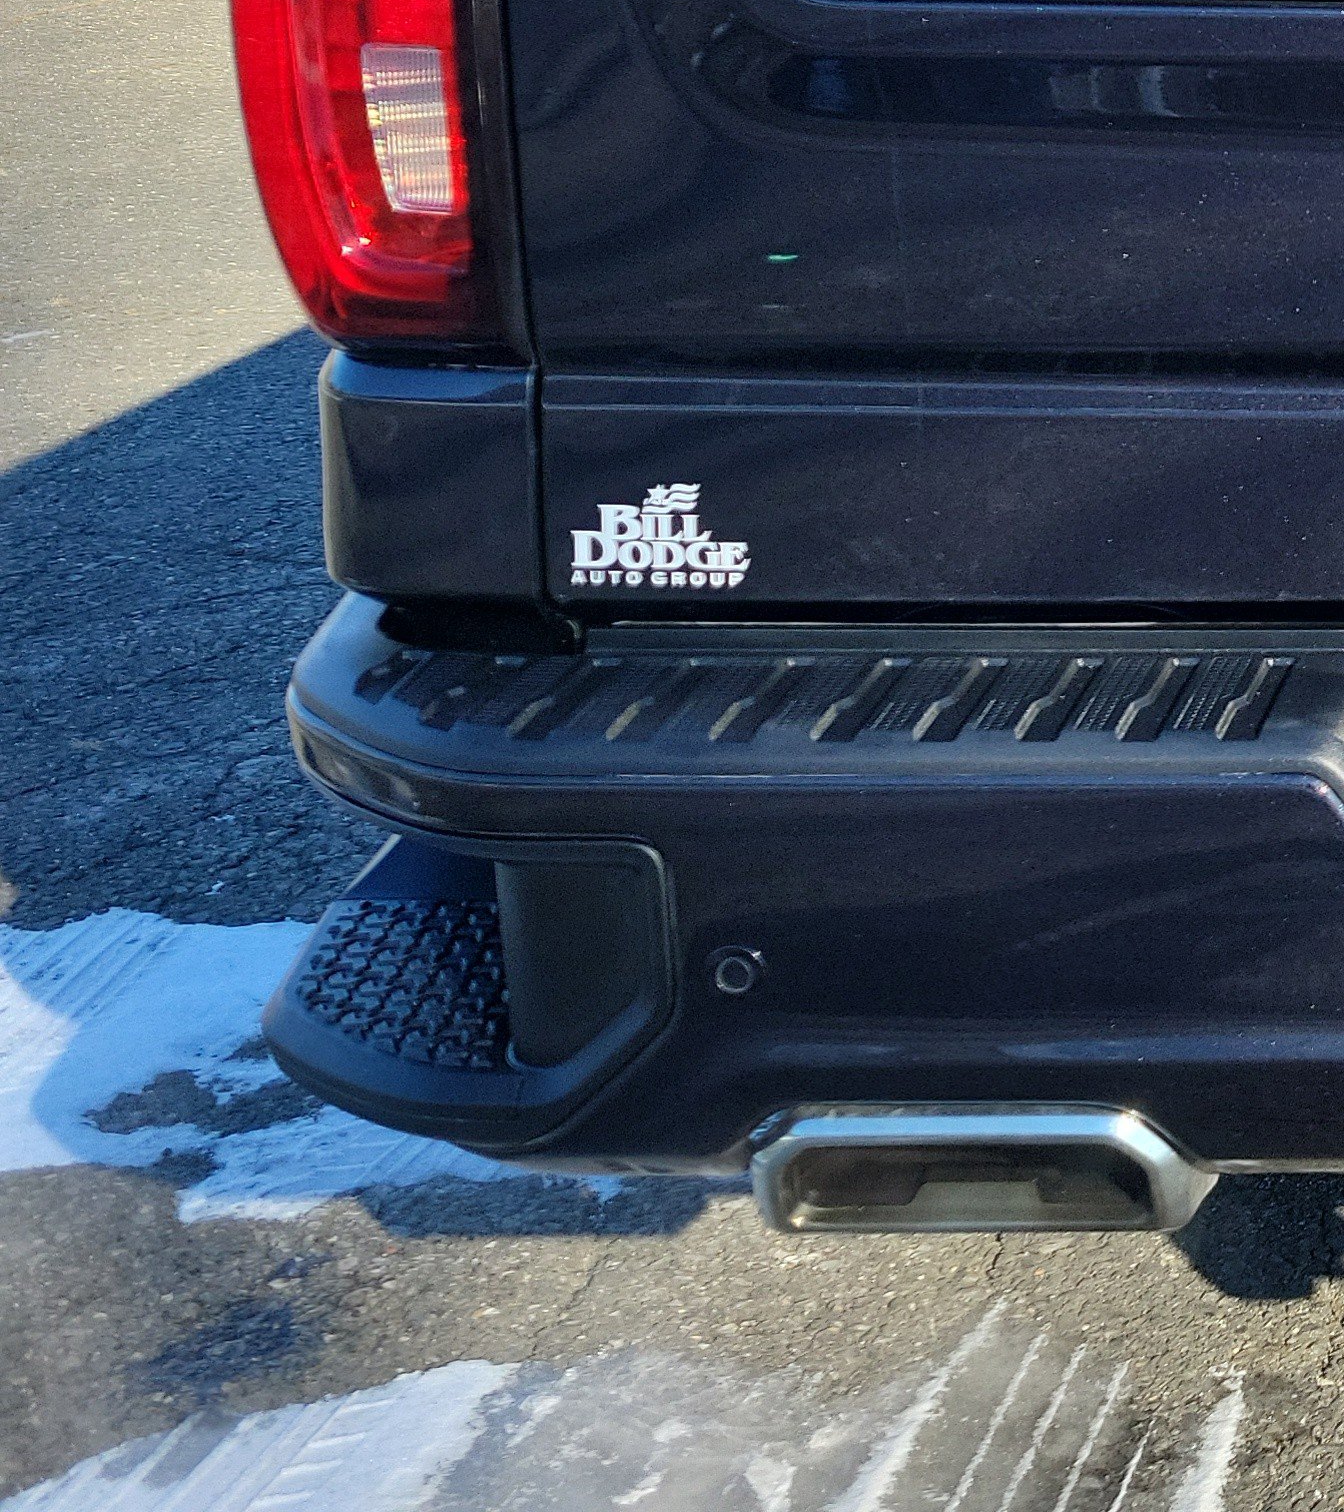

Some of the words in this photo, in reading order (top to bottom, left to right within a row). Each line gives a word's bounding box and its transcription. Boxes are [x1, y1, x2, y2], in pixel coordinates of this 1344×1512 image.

[597, 504, 713, 542] BILL
[570, 530, 751, 571] DODGE
[570, 570, 644, 586] AUTO
[650, 571, 746, 588] GROUP
